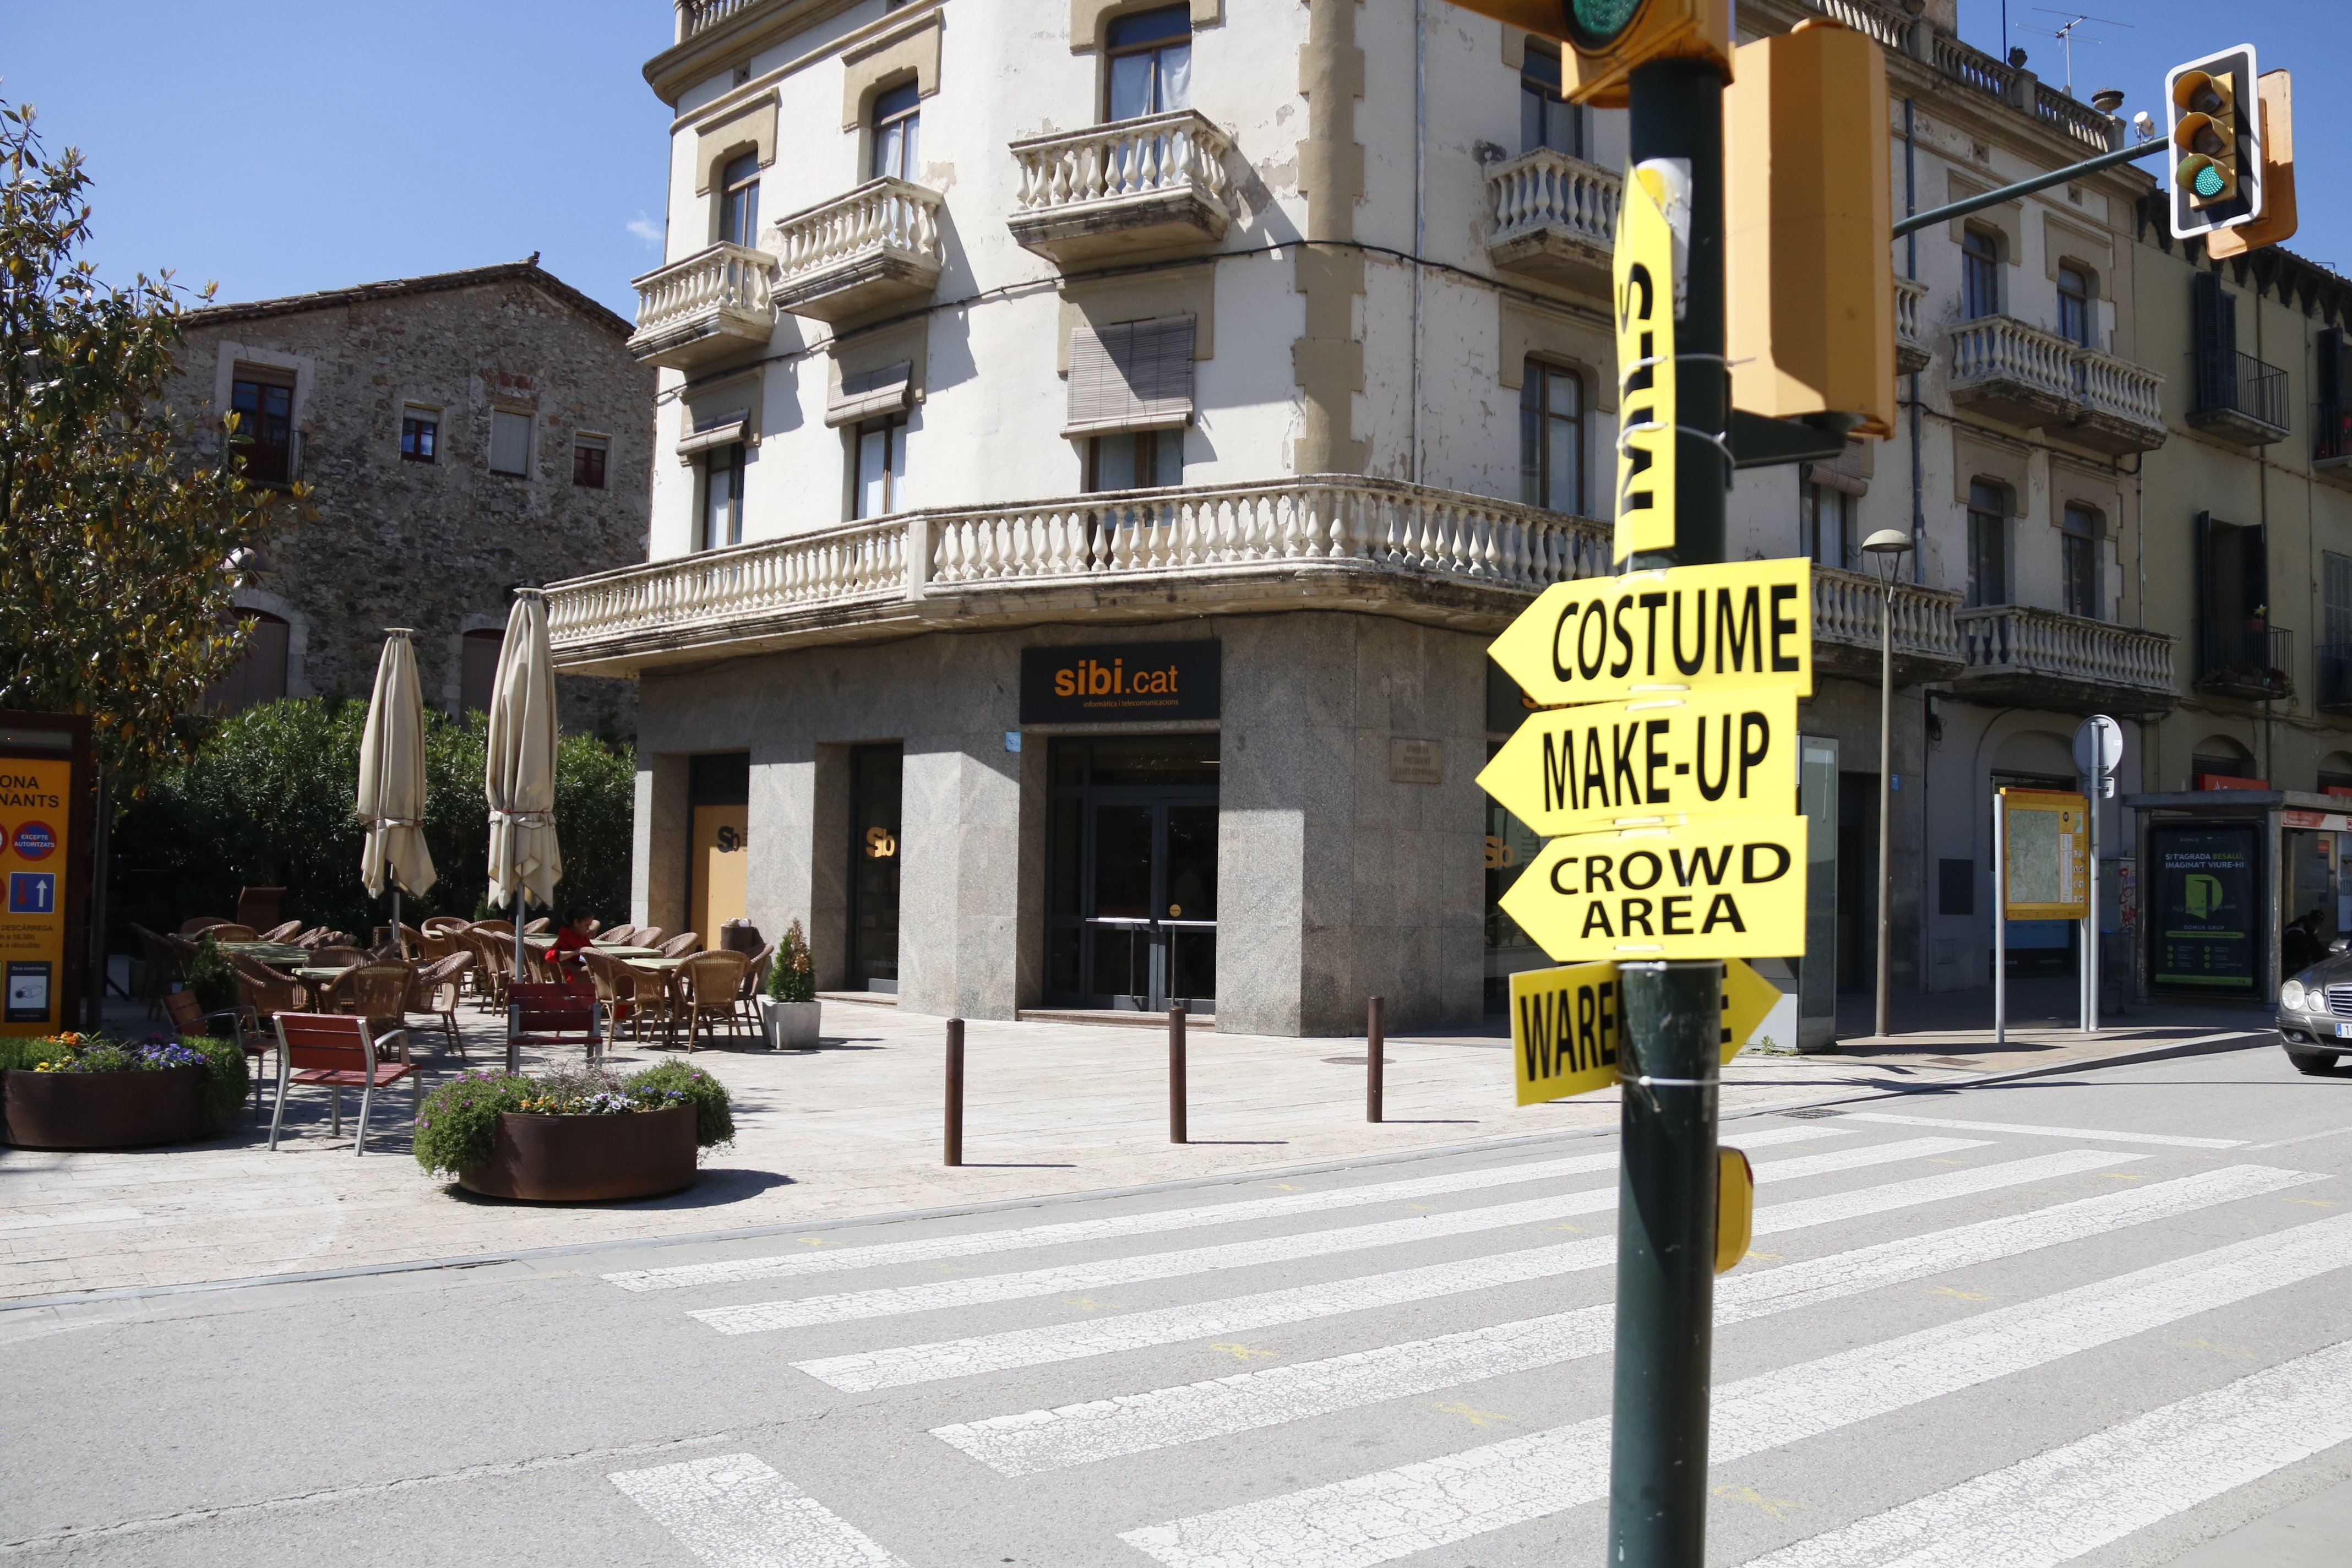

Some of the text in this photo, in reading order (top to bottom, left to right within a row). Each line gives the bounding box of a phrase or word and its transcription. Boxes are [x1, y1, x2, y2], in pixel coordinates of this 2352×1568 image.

[1553, 584, 1800, 682] COSTUME
[1054, 658, 1179, 696] sibi.cat
[1542, 711, 1770, 813] MAKE-UP
[1549, 842, 1792, 896] CROWD
[1581, 894, 1747, 939] AREA
